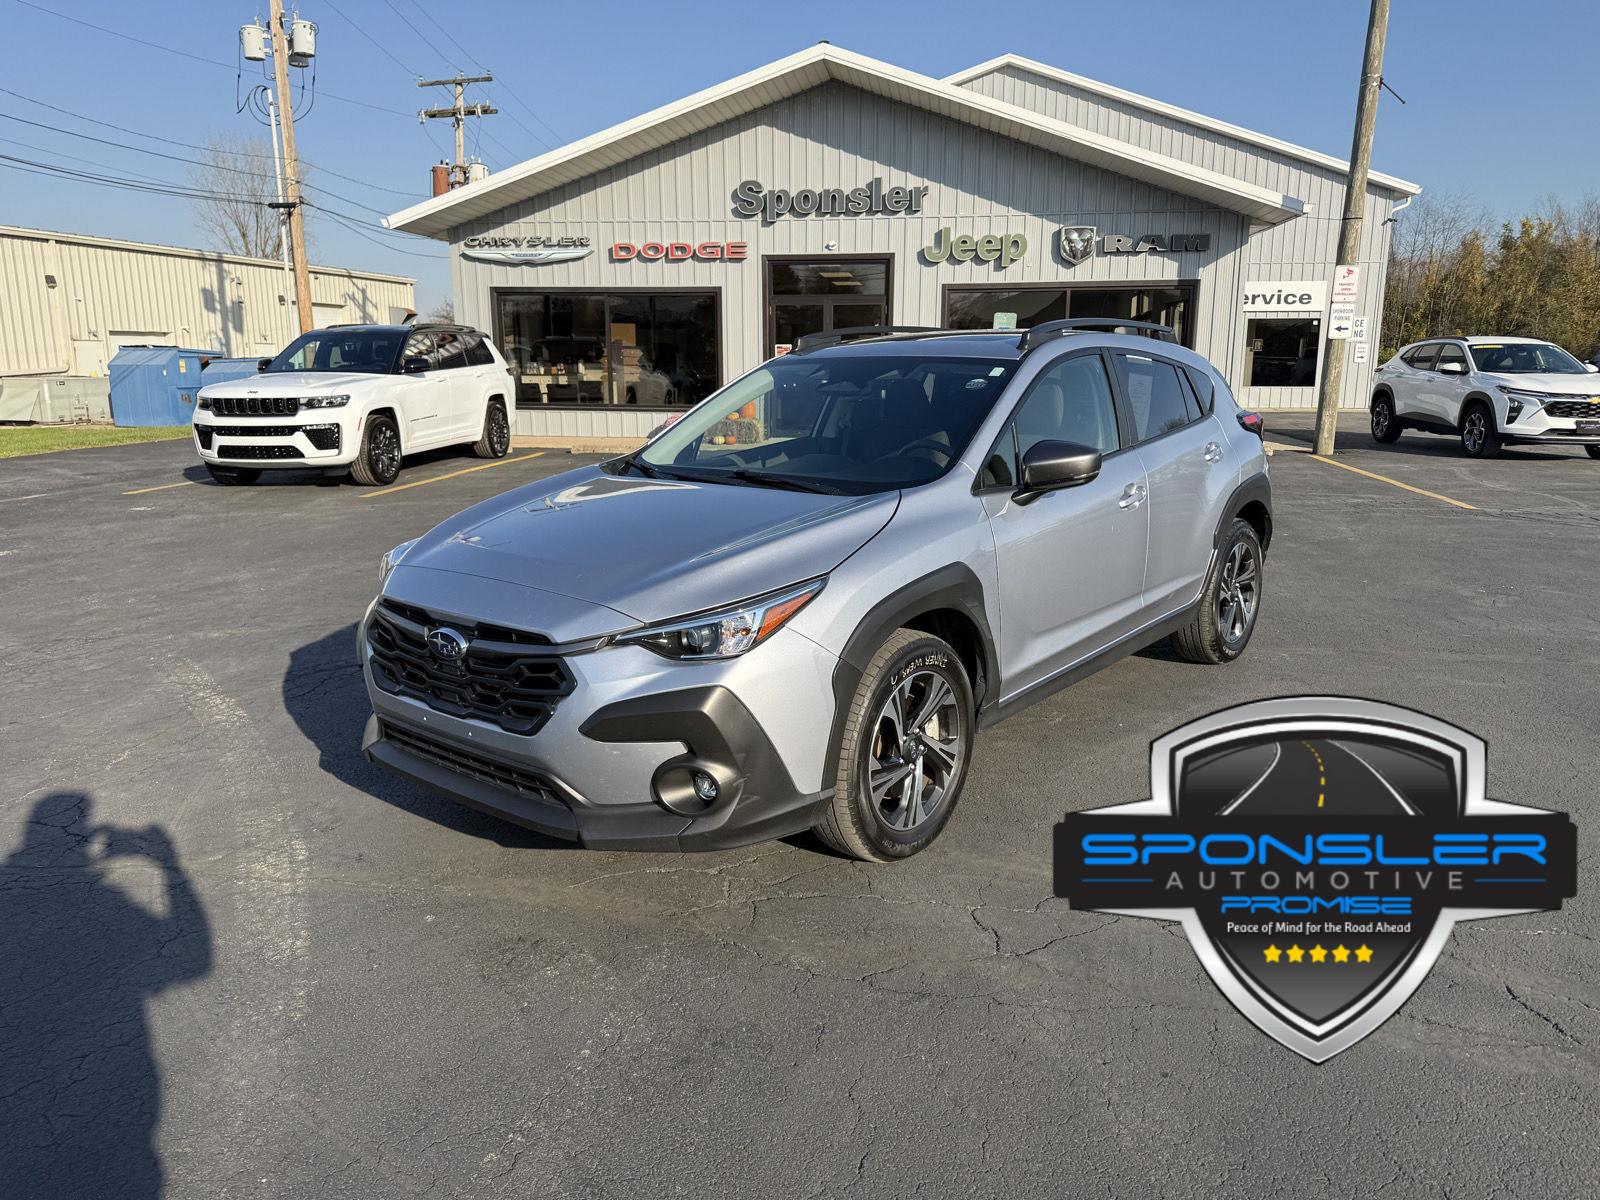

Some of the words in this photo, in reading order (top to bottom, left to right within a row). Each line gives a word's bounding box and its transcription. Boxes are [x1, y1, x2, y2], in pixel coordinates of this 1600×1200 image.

[736, 177, 928, 222] Sponsler
[465, 236, 590, 248] CHRYSLER
[612, 241, 747, 260] DODGE
[924, 226, 1028, 267] Jeep
[1104, 234, 1211, 253] RAM
